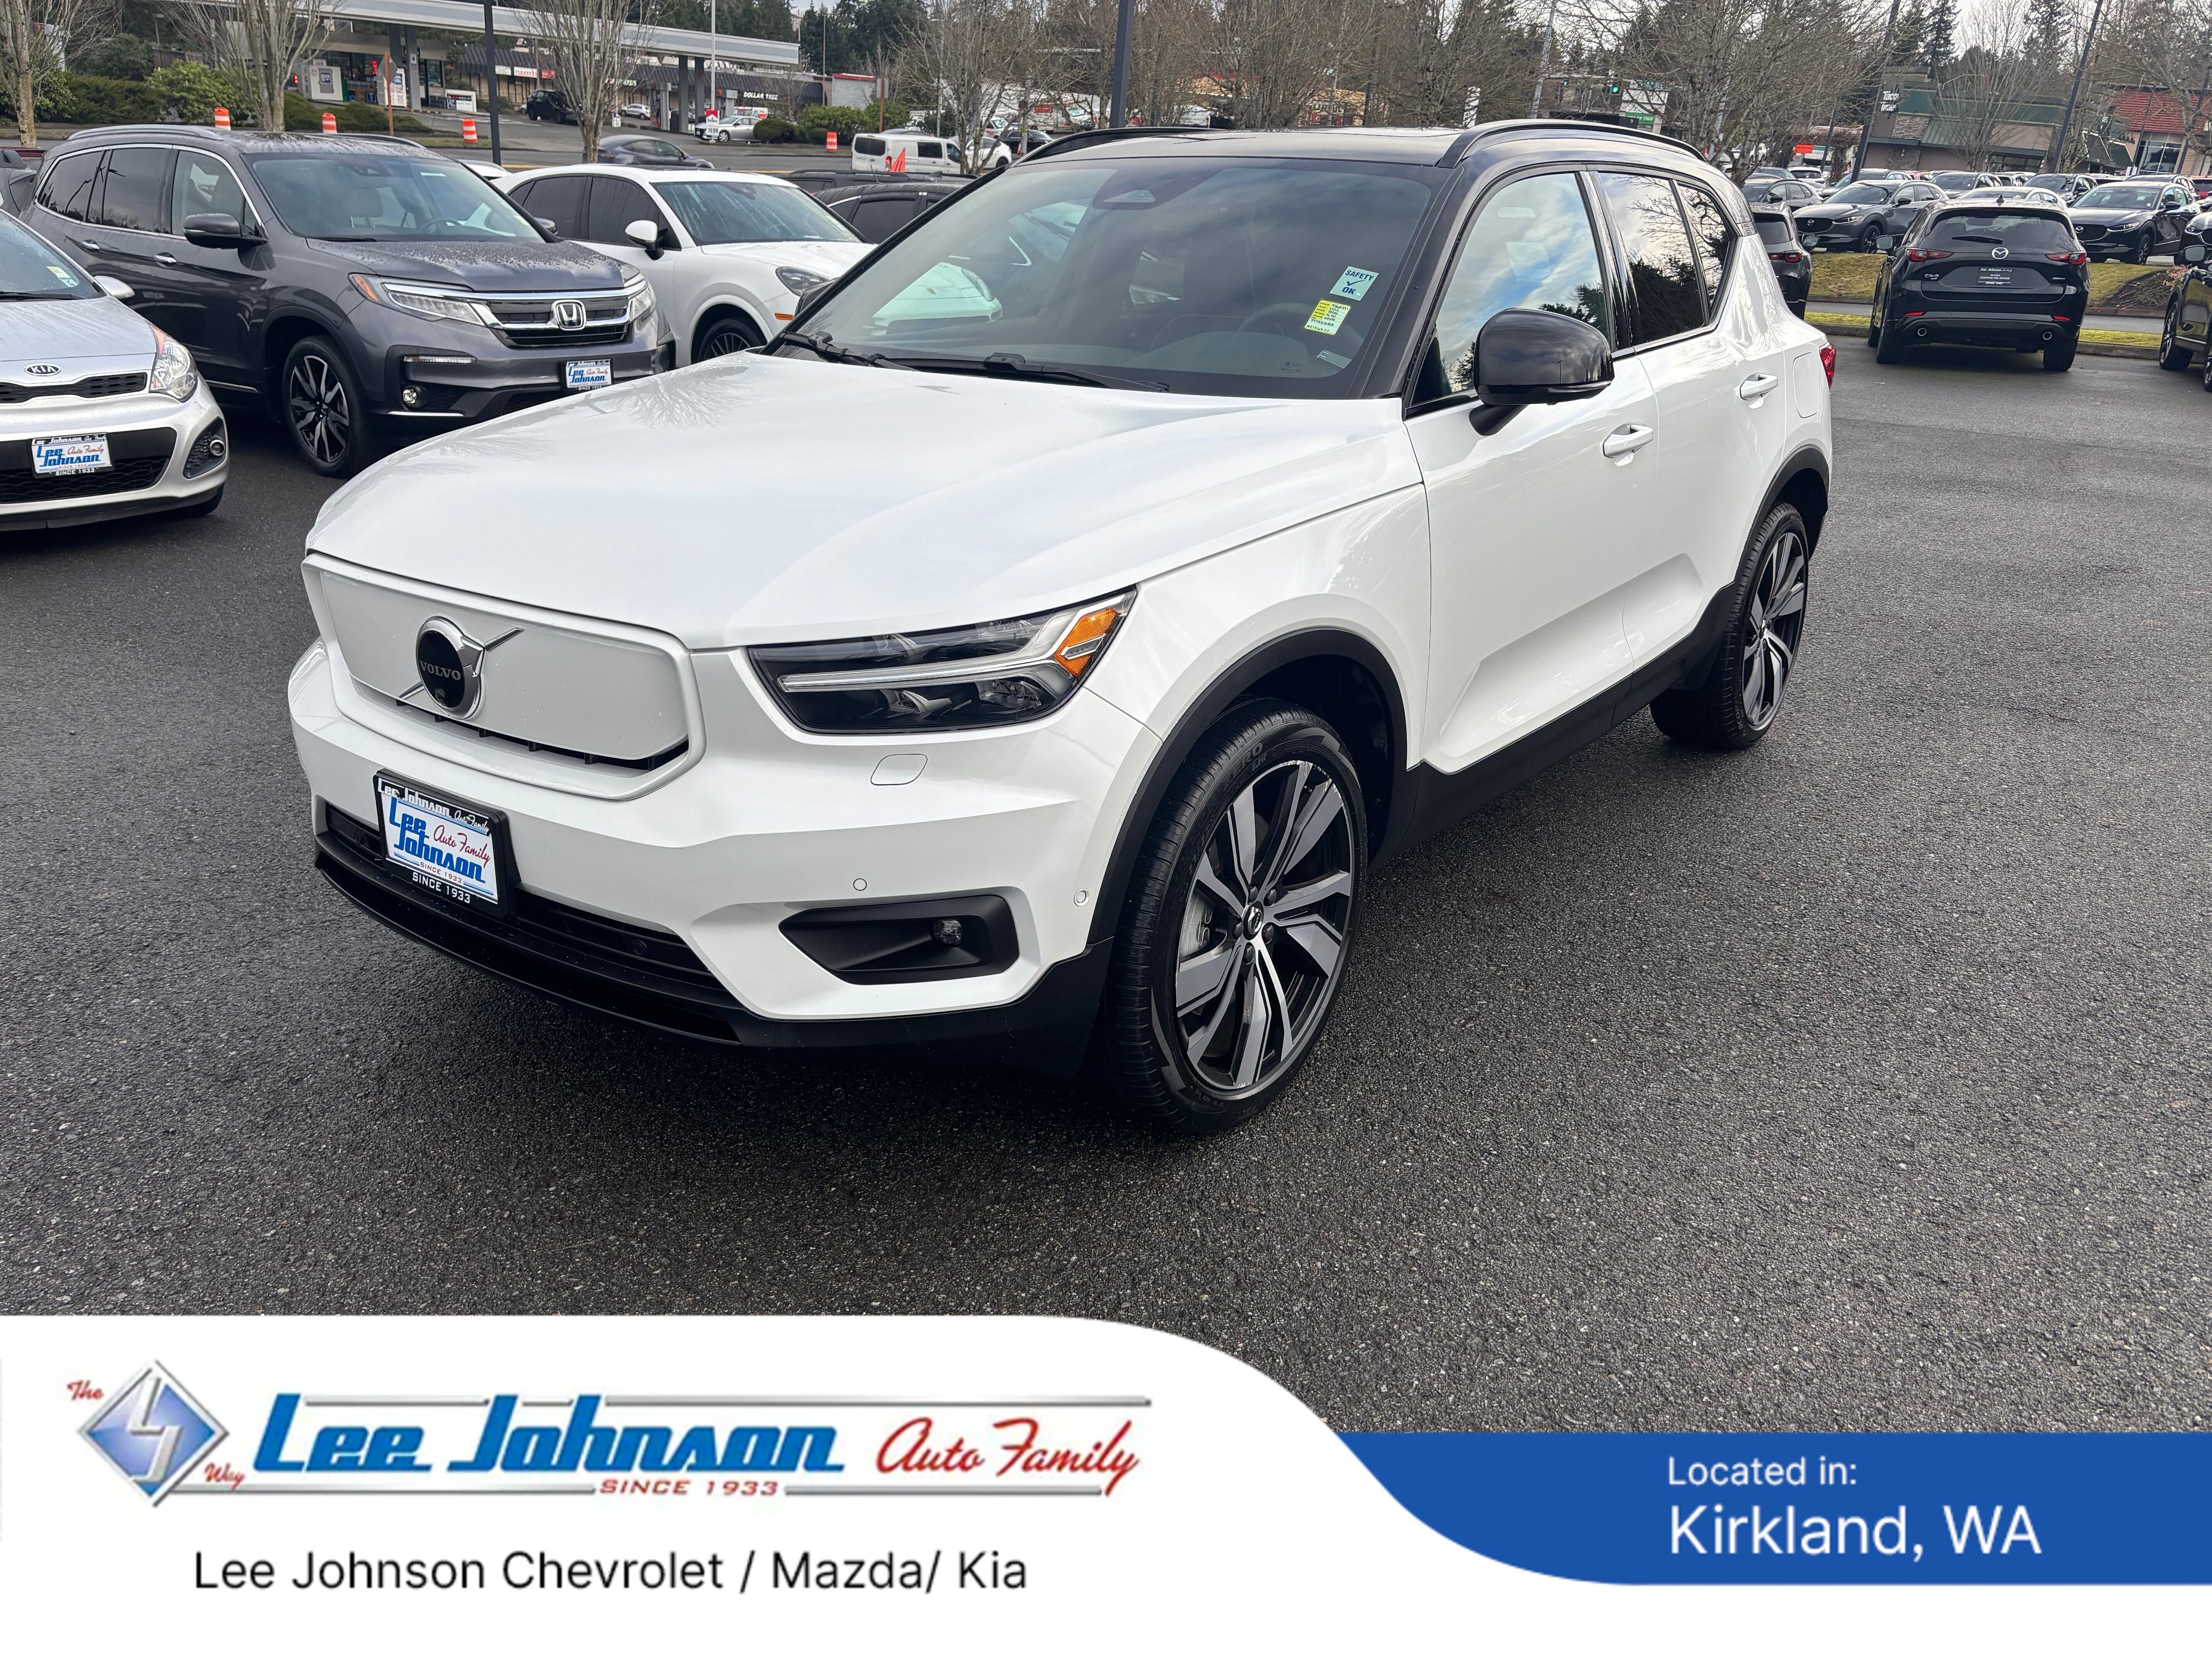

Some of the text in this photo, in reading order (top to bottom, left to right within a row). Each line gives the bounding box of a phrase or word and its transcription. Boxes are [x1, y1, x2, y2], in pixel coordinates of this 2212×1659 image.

[1883, 91, 1899, 100] Taco
[1345, 270, 1374, 281] SAFETY
[1342, 286, 1356, 295] OK
[568, 366, 585, 376] Lee
[570, 374, 606, 383] Johnson
[37, 444, 104, 457] Lee Auto Family
[40, 453, 101, 467] Johnson
[419, 660, 462, 681] VOLVO
[378, 777, 400, 799] Lee
[402, 787, 452, 819] Johnson
[468, 814, 489, 836] Family
[389, 797, 491, 868] Lee Auto Family
[394, 827, 486, 884] Johnson
[420, 862, 462, 883] SINCE 1933
[412, 872, 470, 904] SINCE 1933
